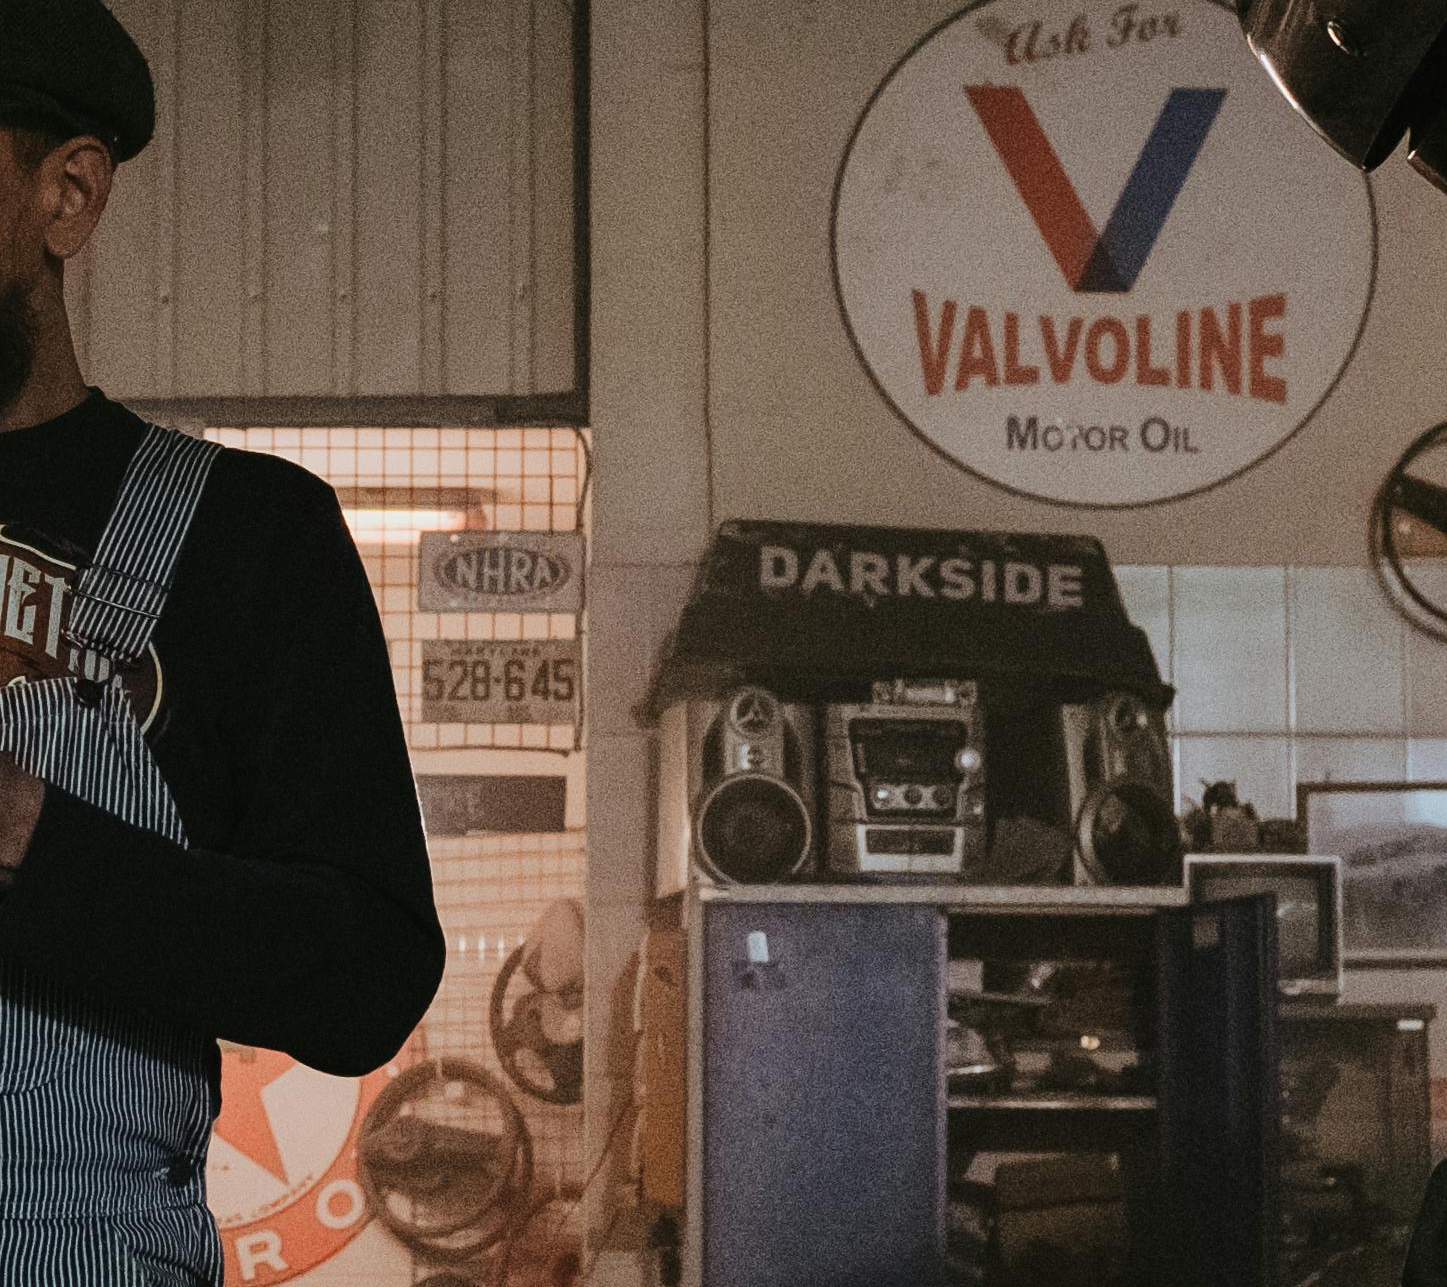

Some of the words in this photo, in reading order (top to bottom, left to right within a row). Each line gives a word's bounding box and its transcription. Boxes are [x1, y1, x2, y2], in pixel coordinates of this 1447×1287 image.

[1002, 22, 1091, 66] Ask
[1107, 5, 1182, 47] For
[912, 288, 1288, 405] VALVOLINE
[455, 548, 554, 594] NHRA
[758, 545, 1087, 608] DARKSIDE
